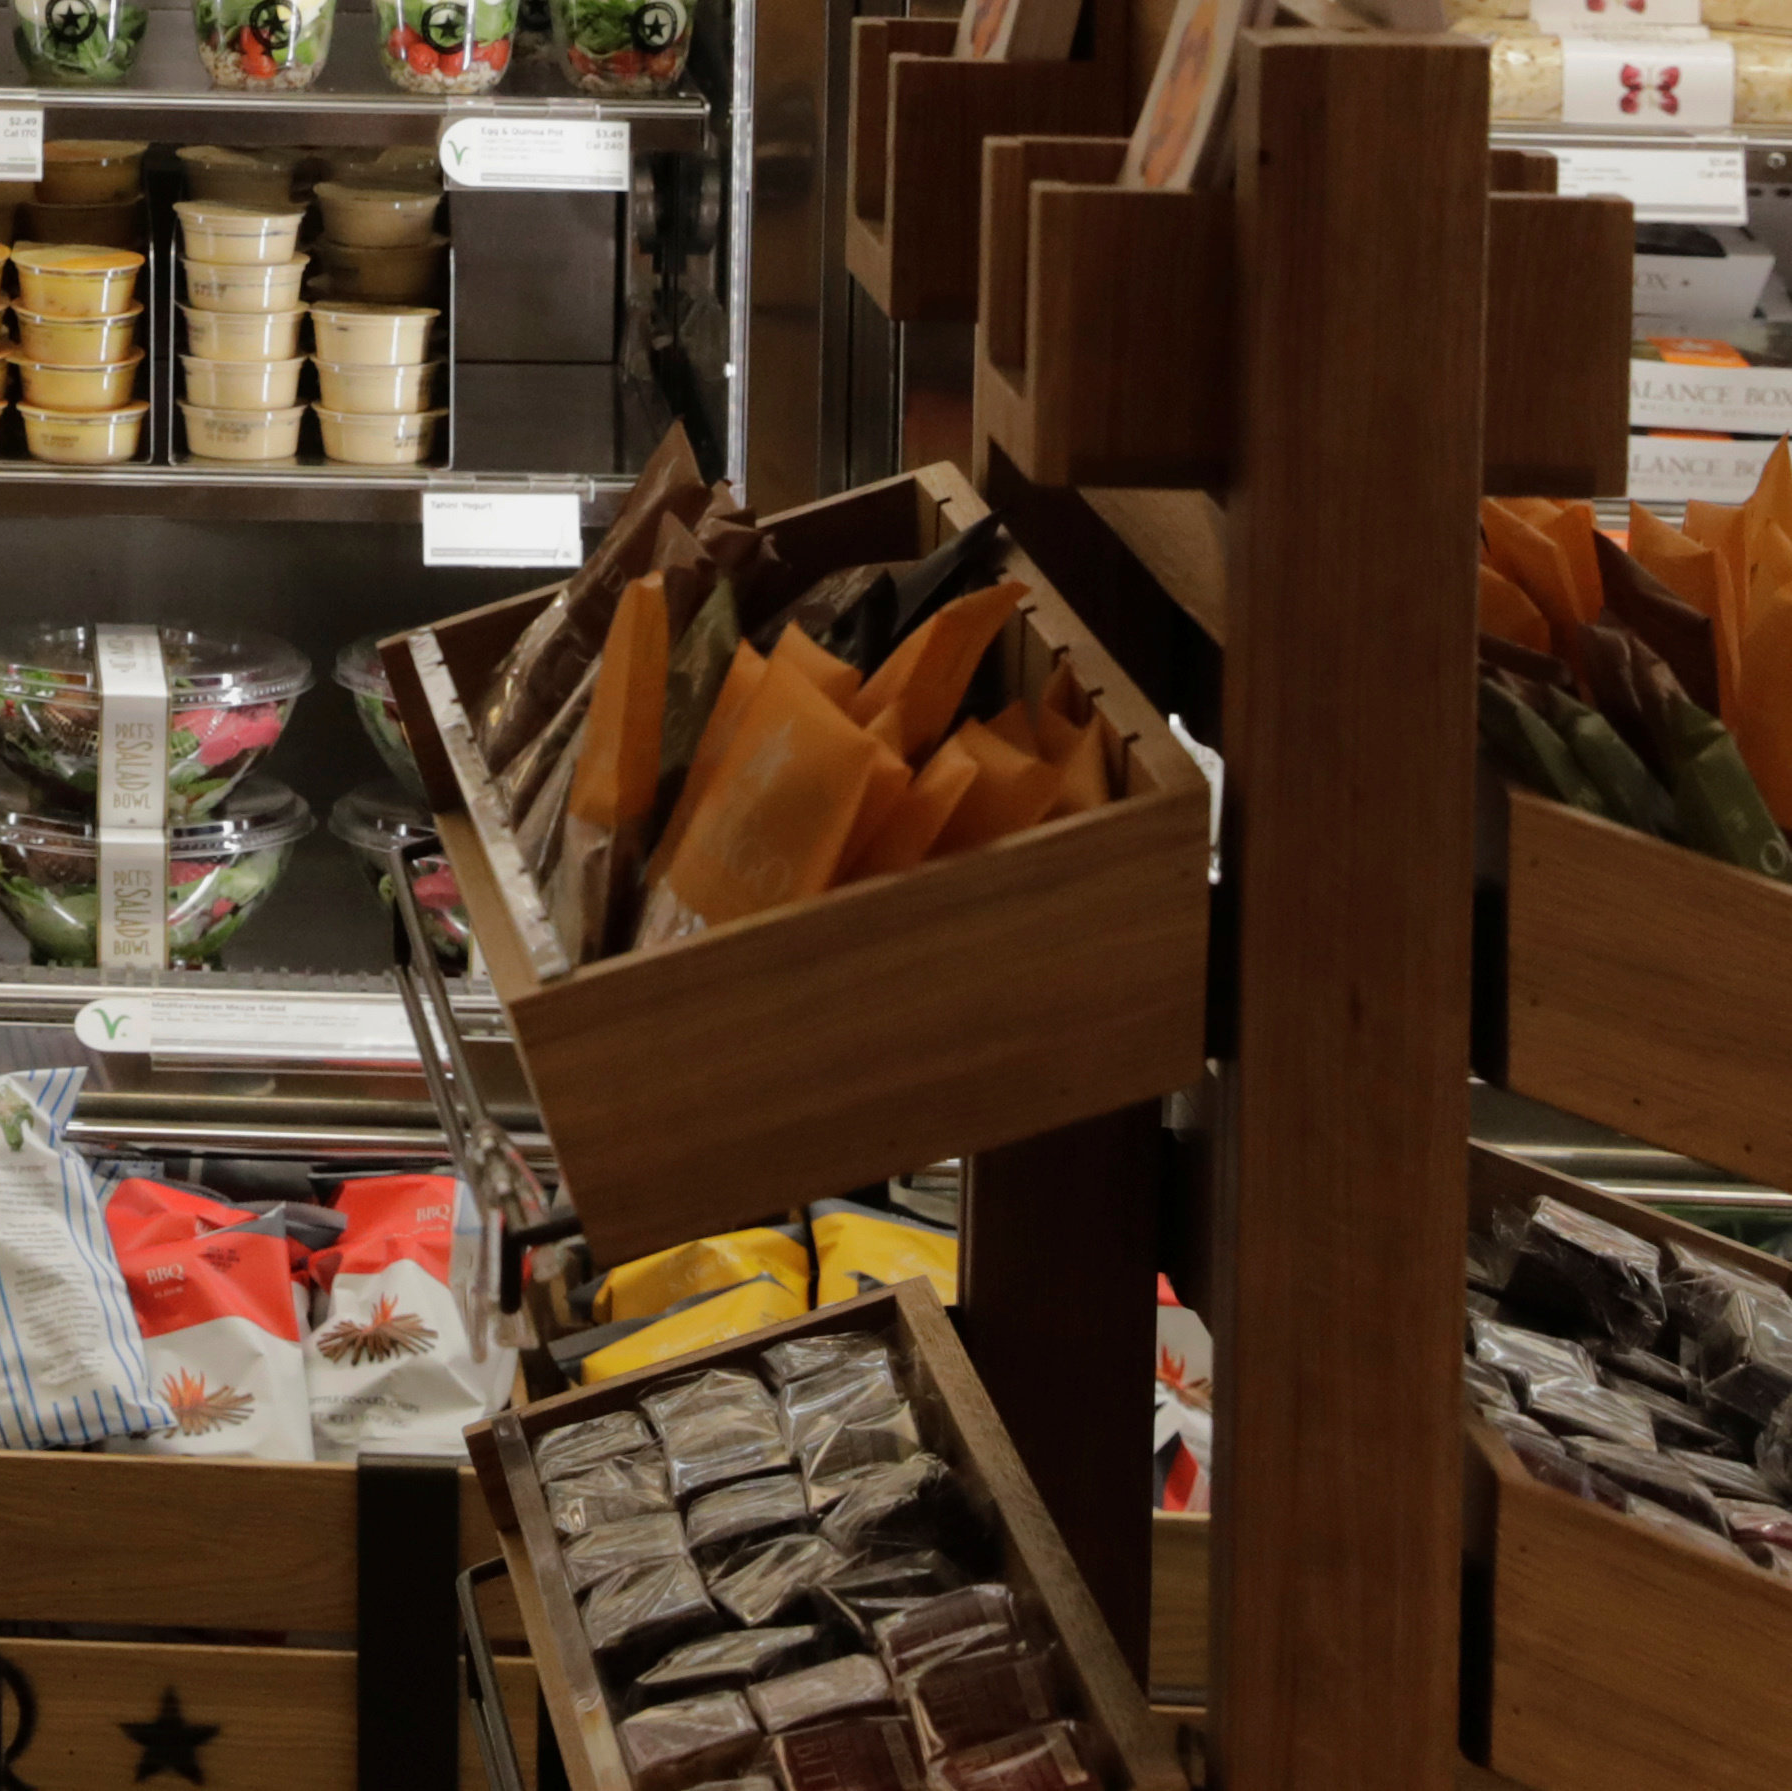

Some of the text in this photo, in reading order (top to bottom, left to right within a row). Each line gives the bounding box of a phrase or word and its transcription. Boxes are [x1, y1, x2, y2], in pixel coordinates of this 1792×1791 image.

[8, 116, 37, 126] $2.49
[3, 128, 19, 138] Cal
[481, 127, 563, 139] Egg Quinoa Pot
[1630, 380, 1729, 405] ALANCE
[430, 500, 492, 511] Tahini Yogurt
[114, 722, 154, 740] PRET'S
[115, 740, 154, 792] SALAD
[113, 793, 152, 810] BOWL
[113, 888, 152, 939] SALAD
[113, 939, 152, 957] BOWL
[151, 1000, 223, 1011] Mediterranean
[415, 1203, 452, 1224] BBQ
[145, 1263, 186, 1286] BBQ
